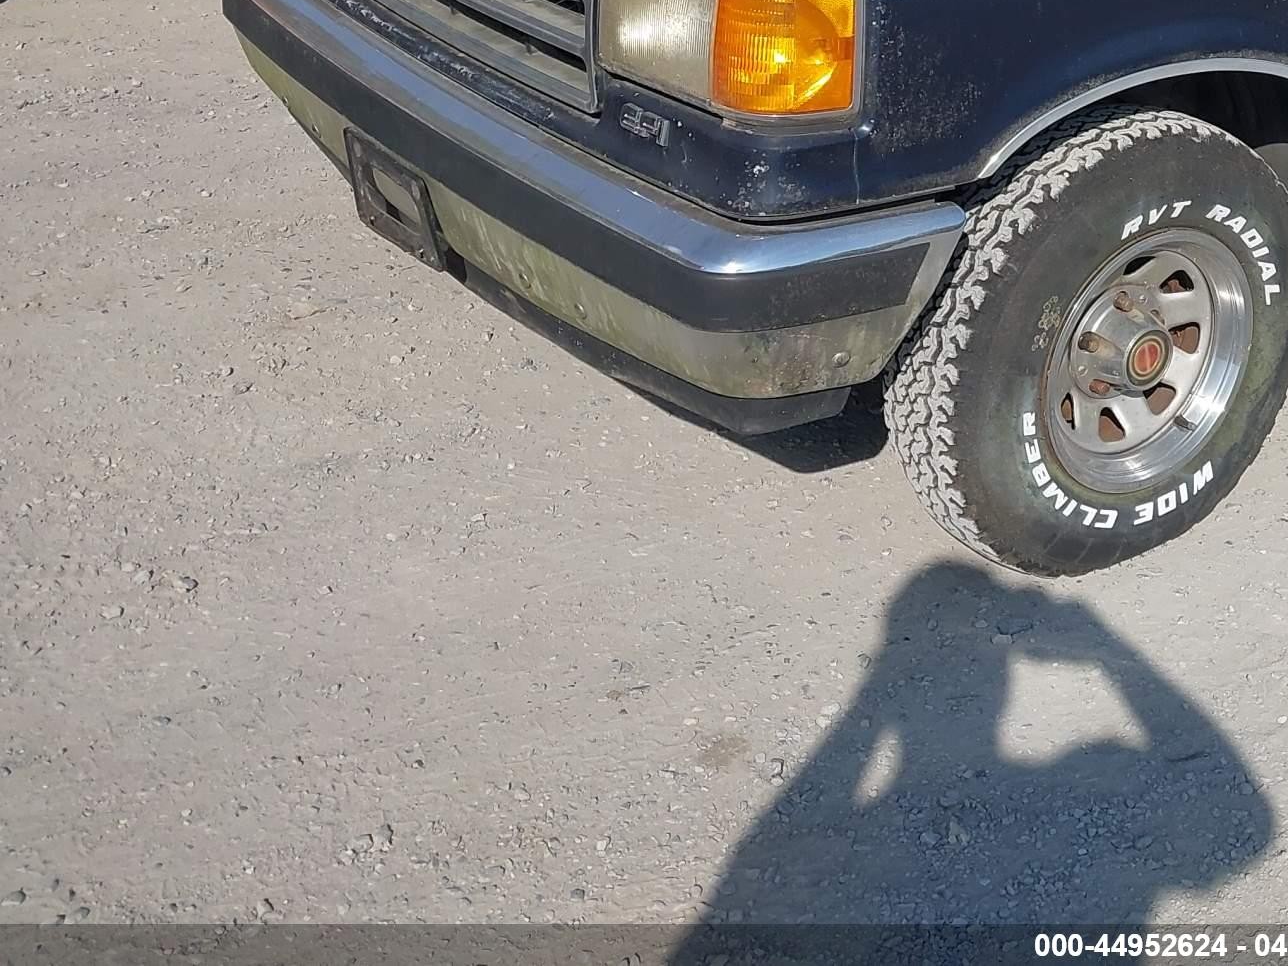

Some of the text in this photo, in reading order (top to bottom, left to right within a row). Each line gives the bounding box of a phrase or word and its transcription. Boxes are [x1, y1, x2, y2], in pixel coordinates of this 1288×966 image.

[1121, 200, 1281, 306] RVT RADIAL
[1022, 412, 1214, 529] WIDE CLIMBER
